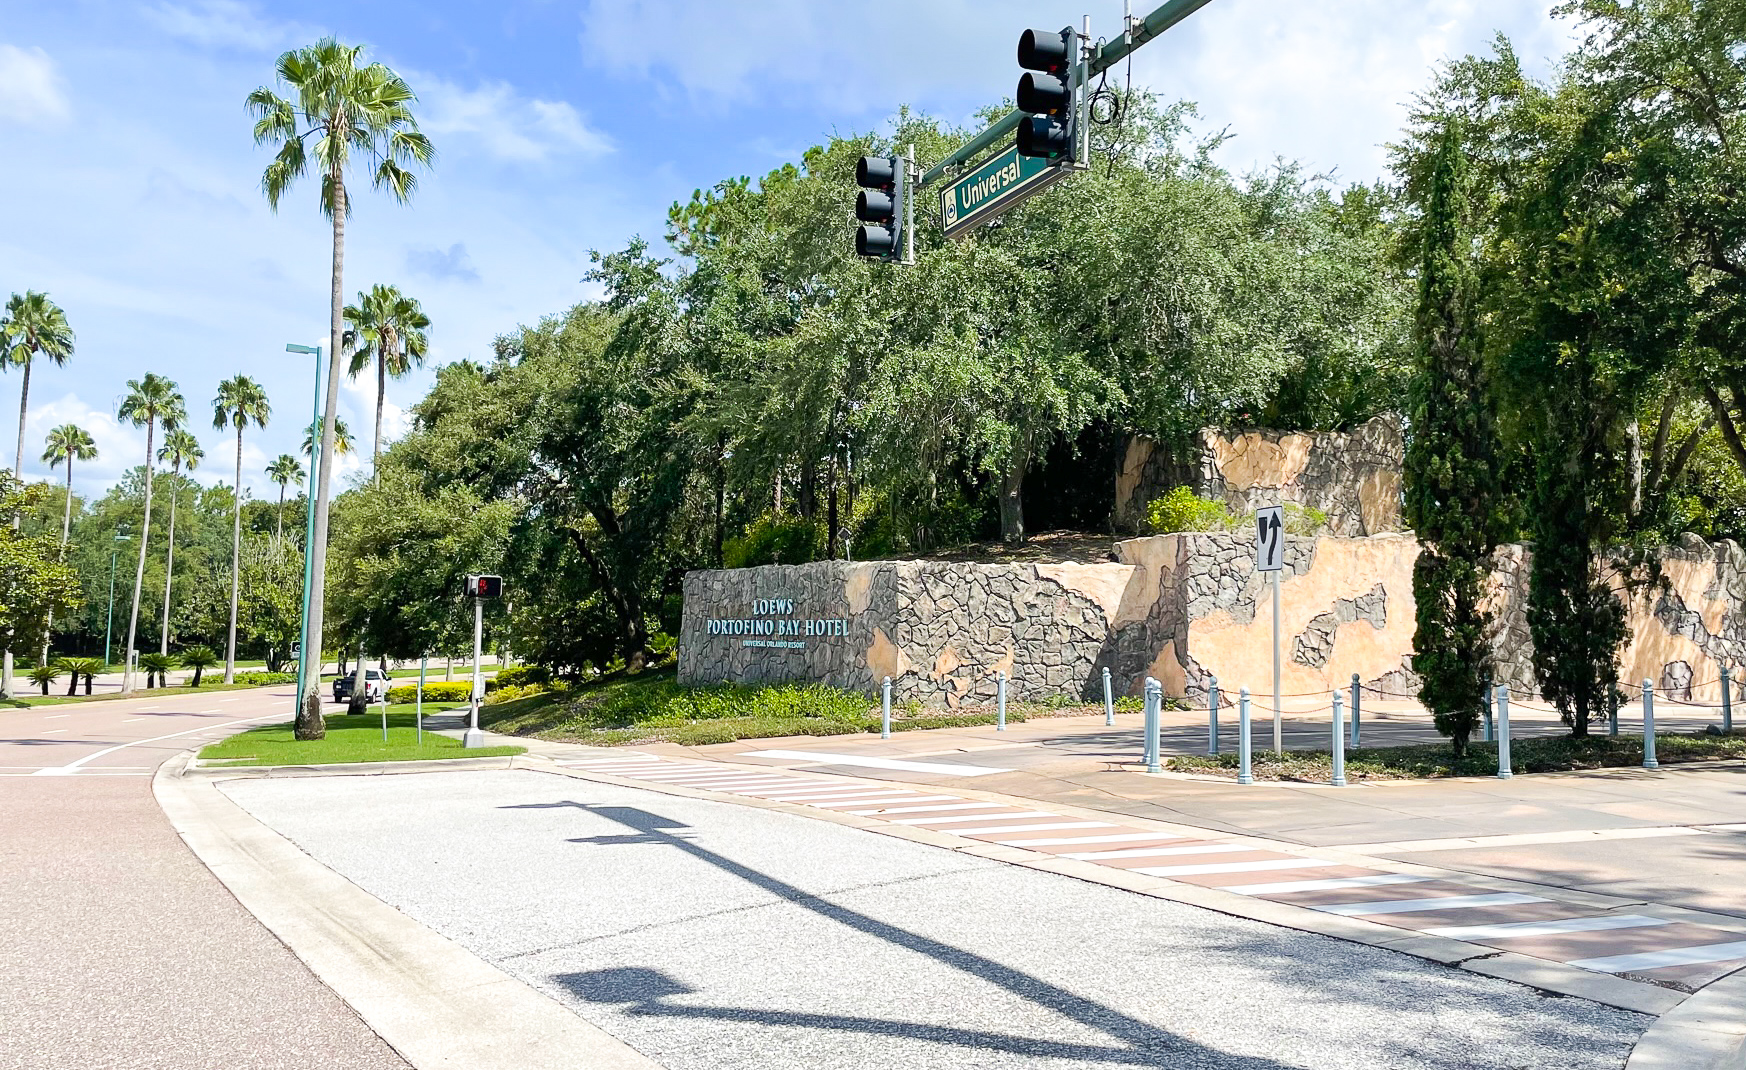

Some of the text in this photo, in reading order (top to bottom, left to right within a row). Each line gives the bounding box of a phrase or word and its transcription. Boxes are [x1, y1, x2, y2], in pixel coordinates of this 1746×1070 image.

[961, 152, 1021, 209] Universal
[753, 599, 794, 615] LOEWS
[707, 619, 849, 636] PORTOFINO BAY HOTEL
[742, 639, 806, 649] UNIVERSAL ORLANDO RESORT
